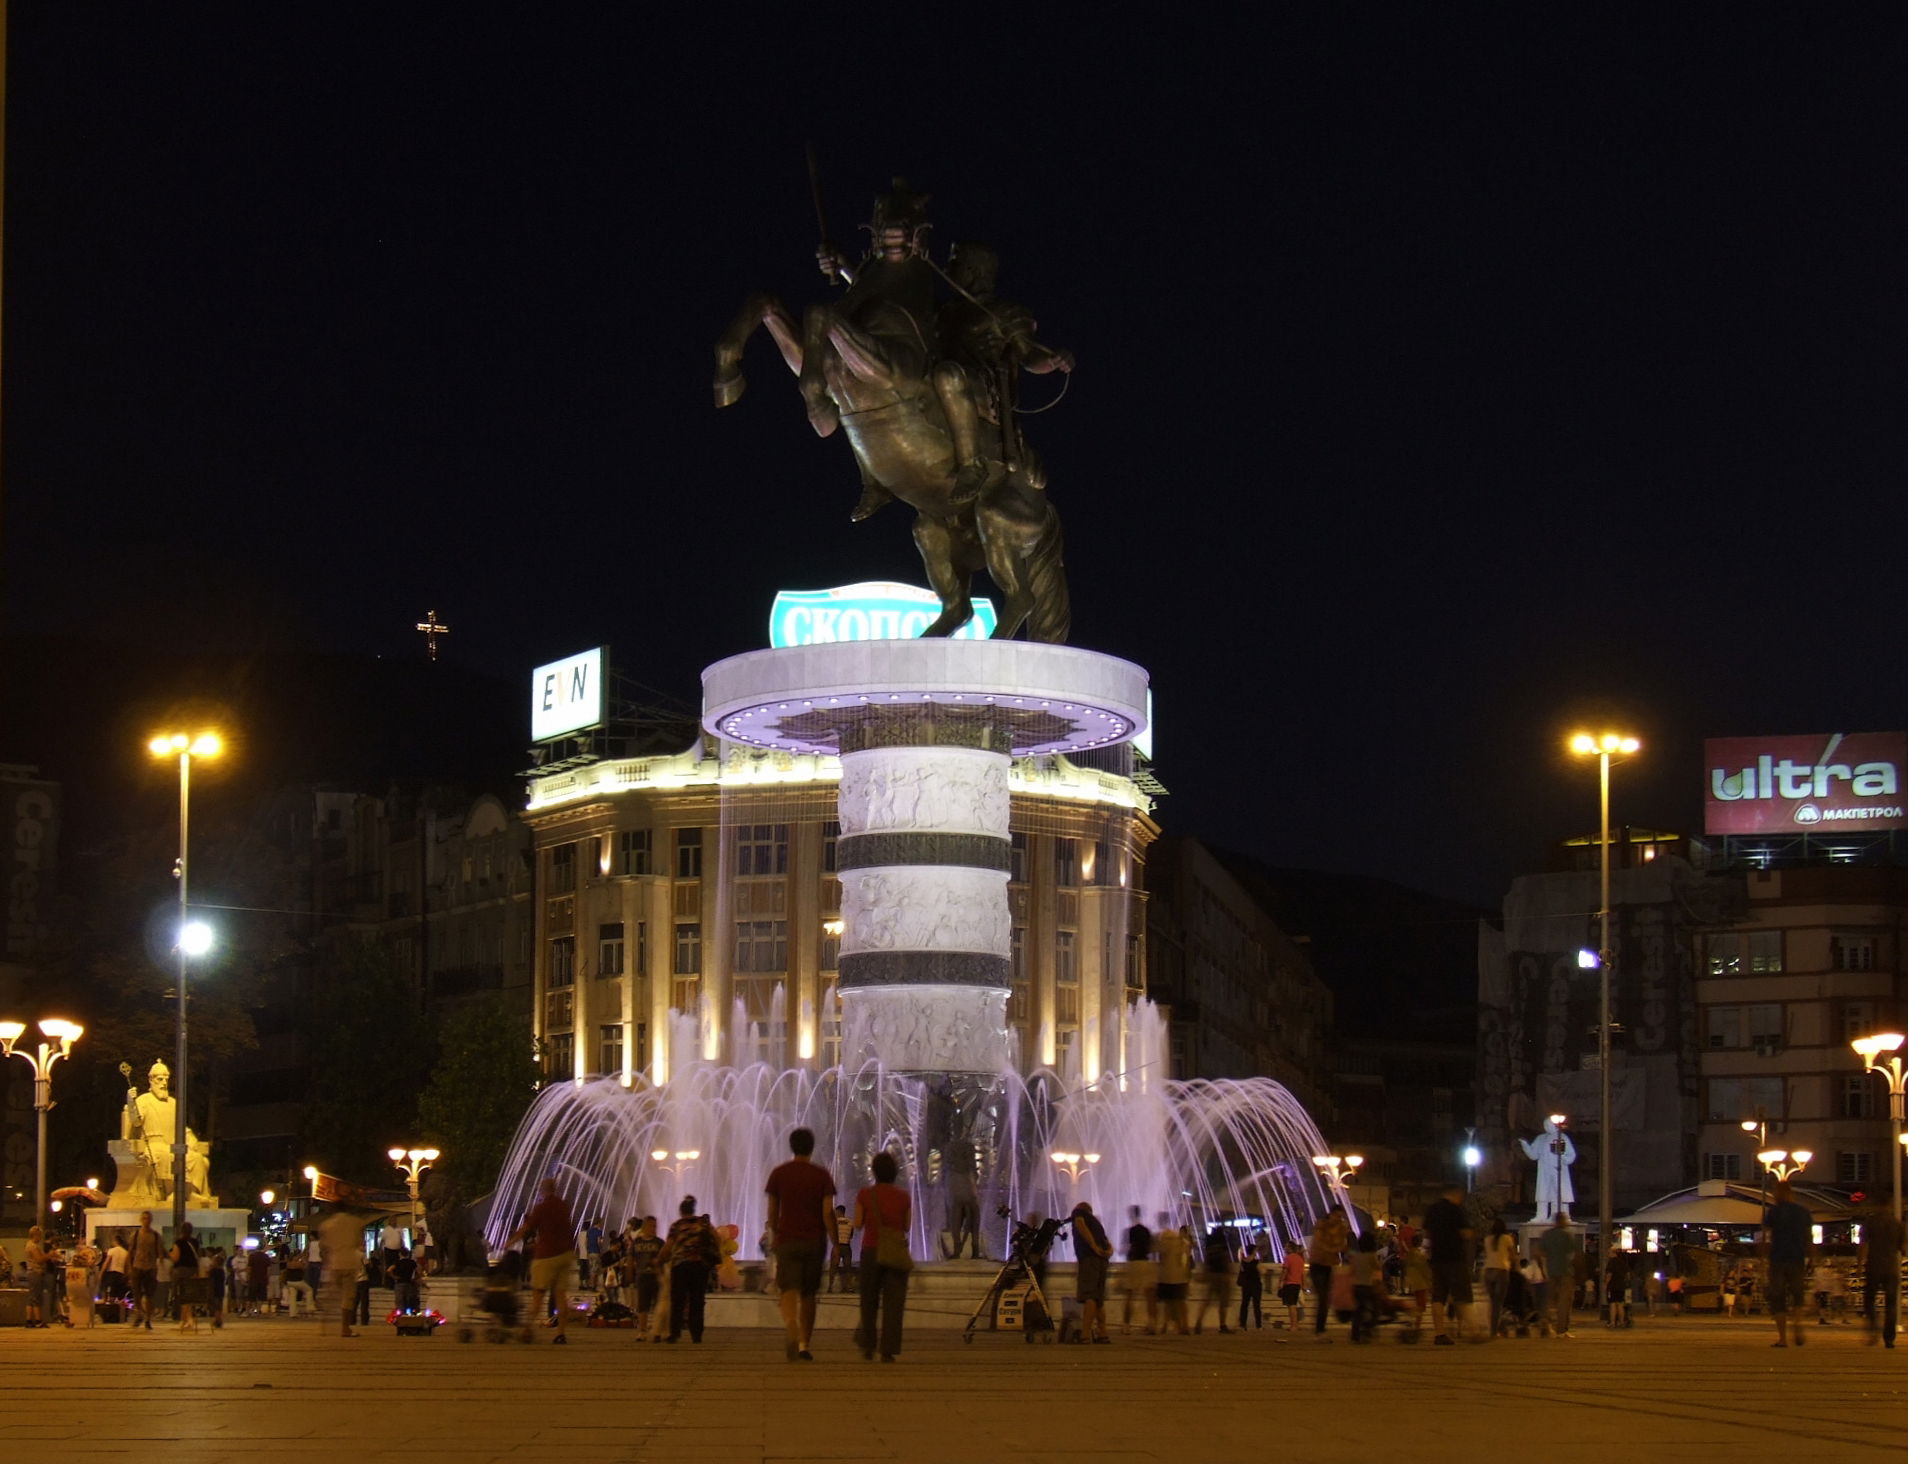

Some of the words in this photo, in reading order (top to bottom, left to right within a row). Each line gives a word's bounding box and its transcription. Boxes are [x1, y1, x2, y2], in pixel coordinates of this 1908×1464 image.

[784, 606, 987, 649] СКОПСО
[1712, 750, 1898, 801] ultra
[1822, 805, 1903, 820] МАКПЕТРОЛ
